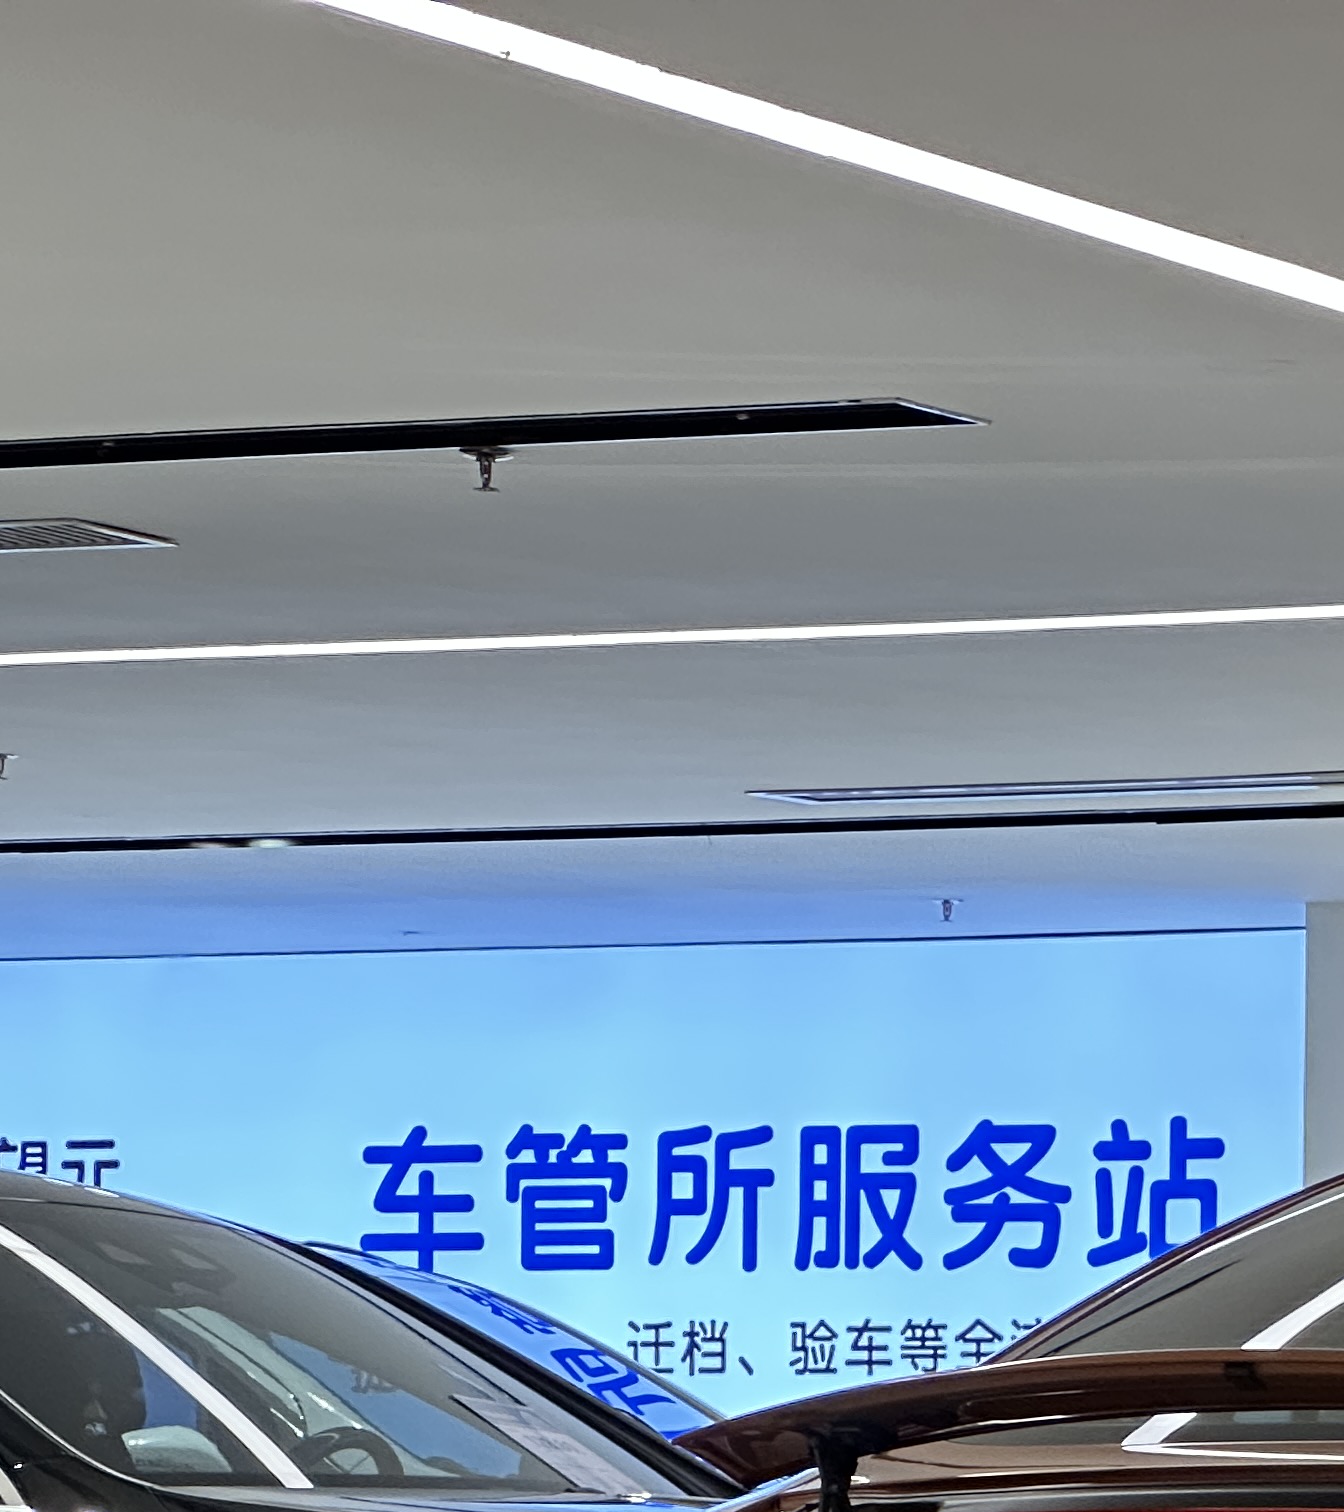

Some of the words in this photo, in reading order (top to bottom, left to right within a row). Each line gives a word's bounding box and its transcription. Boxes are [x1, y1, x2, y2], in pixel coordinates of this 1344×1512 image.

[358, 1115, 1228, 1274] 车管所服务站
